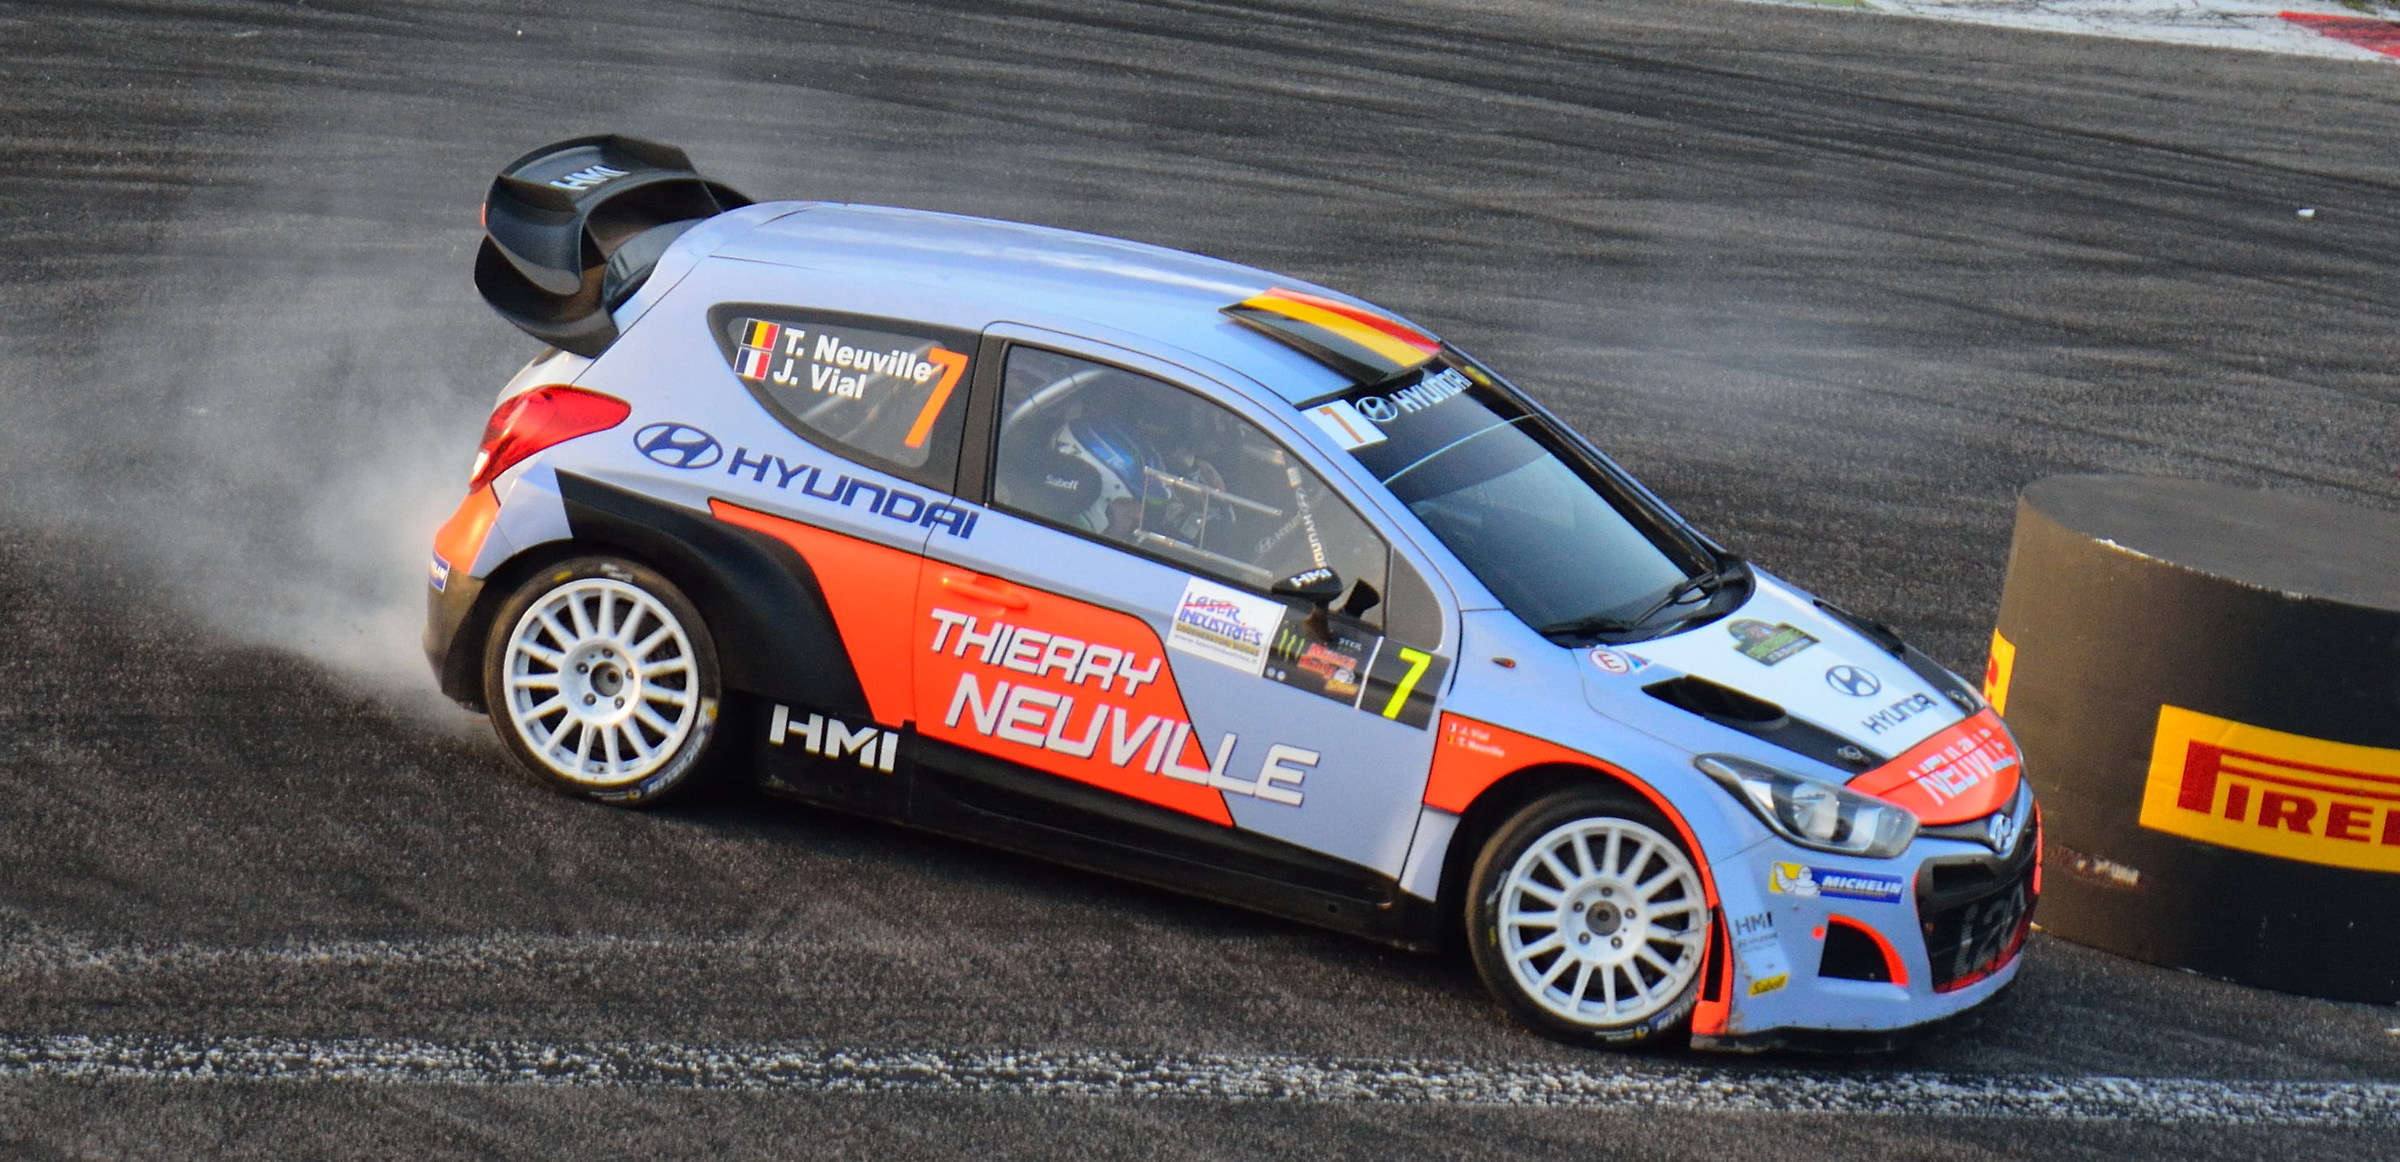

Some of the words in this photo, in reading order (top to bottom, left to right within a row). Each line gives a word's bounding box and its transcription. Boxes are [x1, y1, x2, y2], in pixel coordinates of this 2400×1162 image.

[550, 165, 630, 190] HMI
[773, 359, 798, 385] J.
[811, 363, 867, 399] Vial
[784, 328, 806, 356] T.
[813, 334, 932, 382] Neuville
[904, 347, 969, 448] 7
[727, 448, 979, 539] HYUNDAI
[930, 609, 1162, 697] THIERRY
[1382, 647, 1432, 720] 7
[768, 704, 899, 773] HMI
[945, 674, 1321, 807] NEUVILLE
[1822, 875, 1902, 894] MICHELIN
[1734, 911, 1773, 935] HMI
